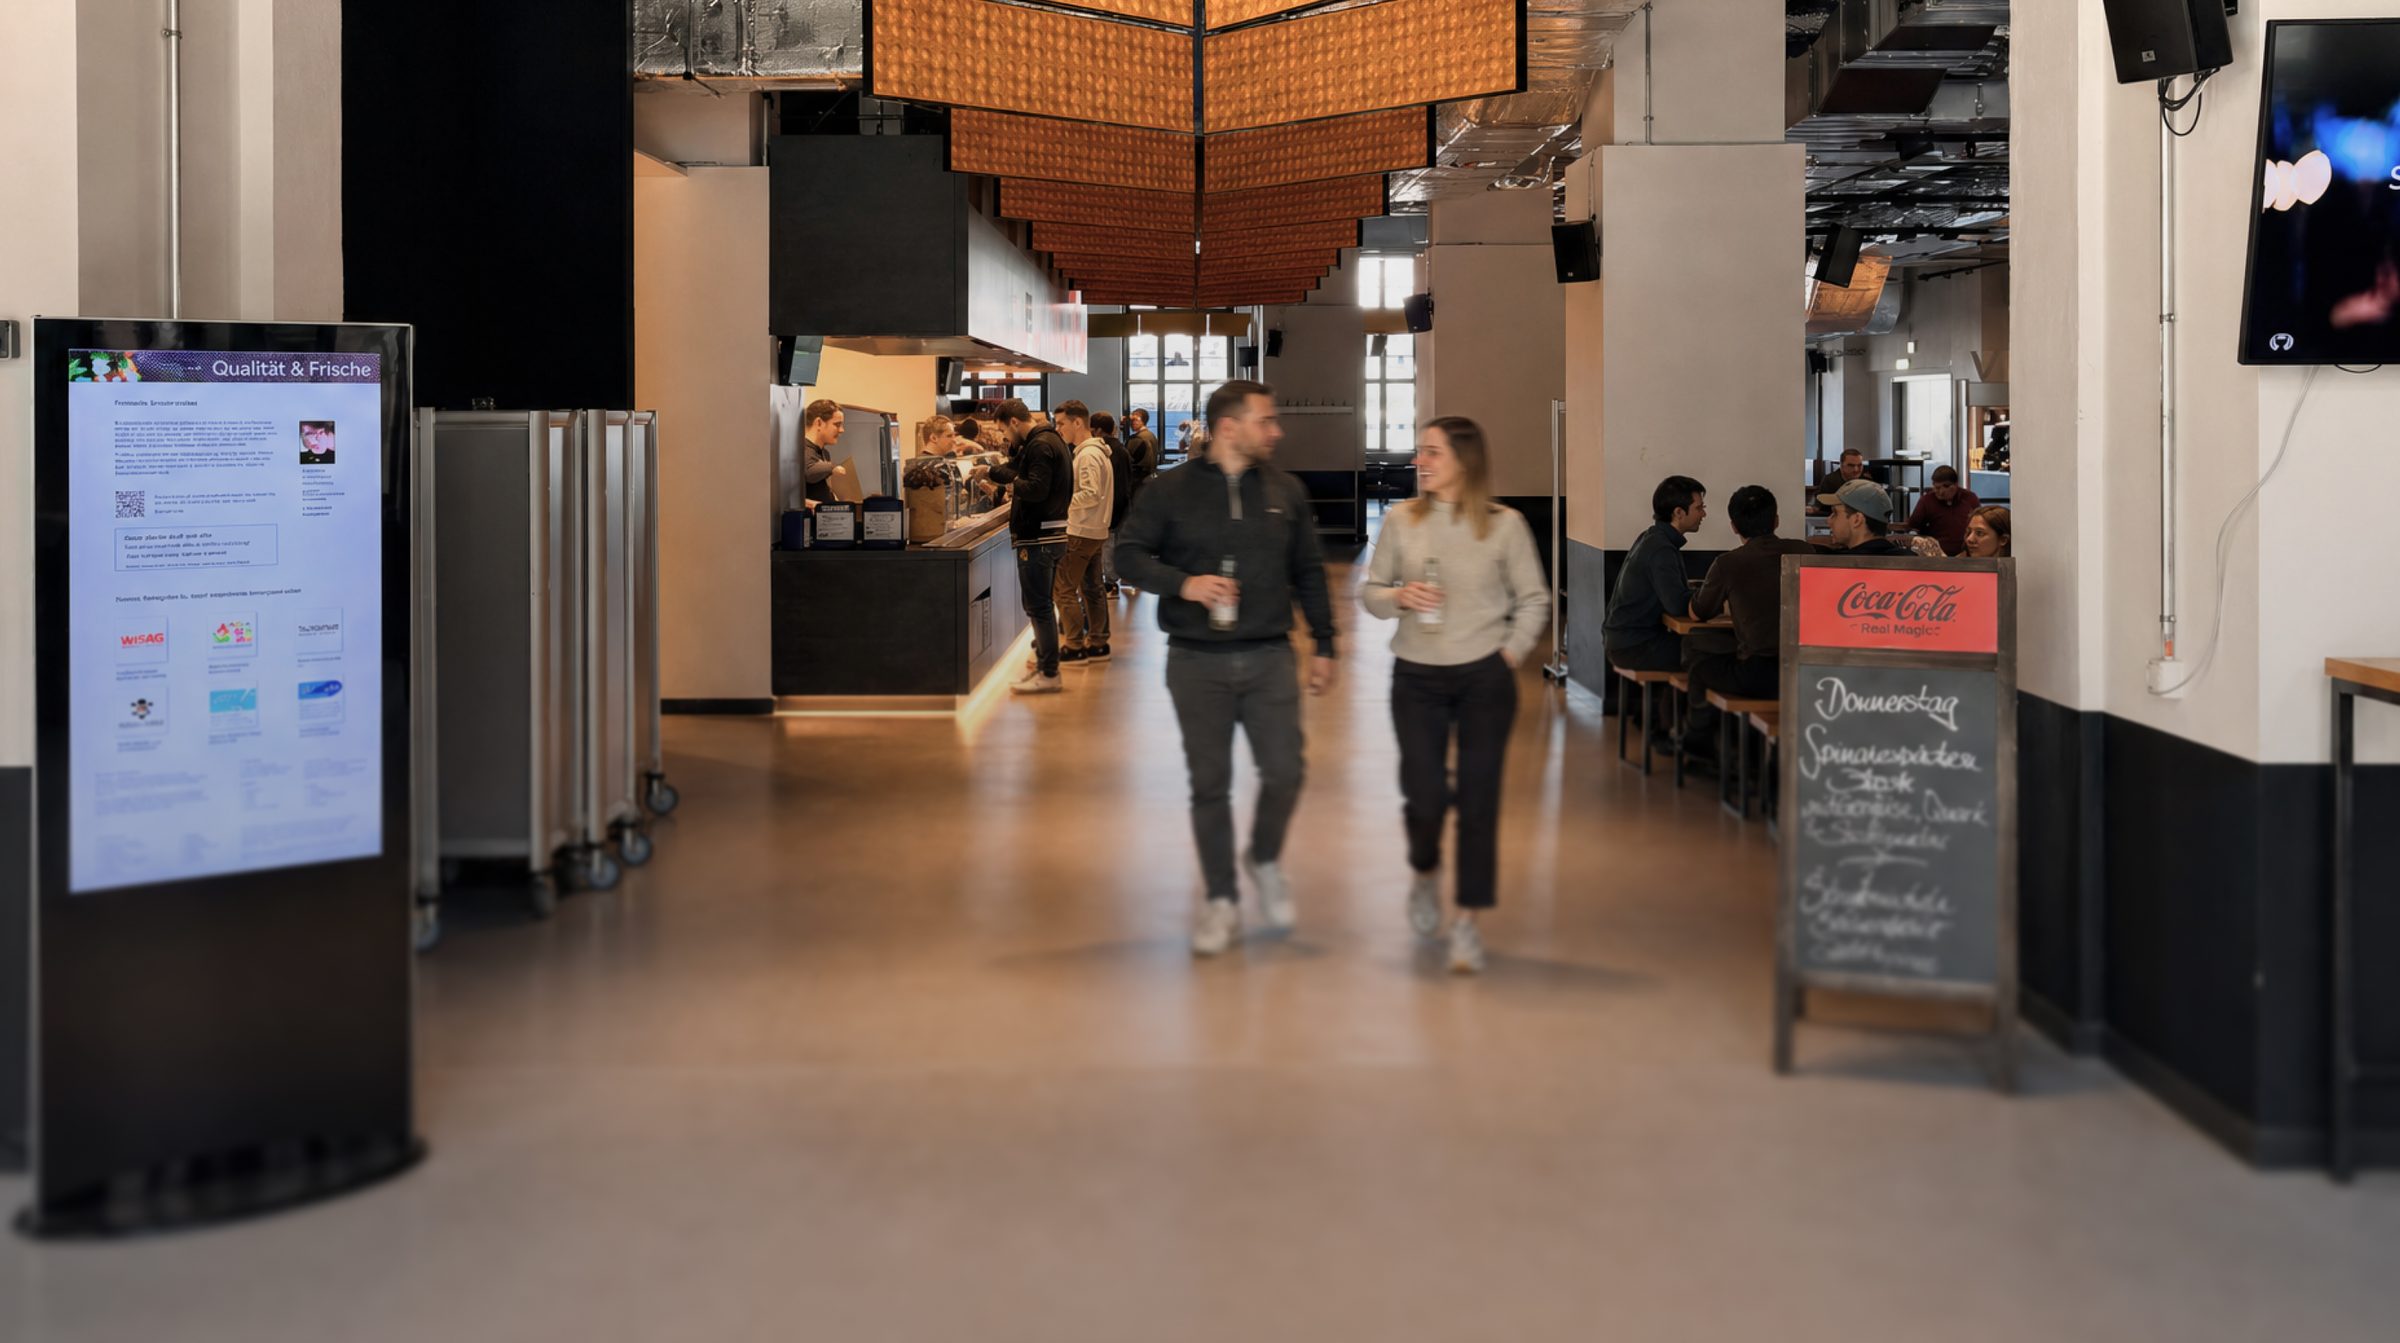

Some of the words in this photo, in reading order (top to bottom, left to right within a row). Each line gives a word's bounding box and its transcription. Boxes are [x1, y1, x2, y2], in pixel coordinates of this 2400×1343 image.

[212, 360, 286, 377] Qualität
[290, 361, 304, 377] &
[309, 361, 372, 377] Frische
[1837, 582, 1964, 622] Coca-Cola
[1861, 623, 1890, 634] Real
[120, 632, 165, 646] WISAG
[1815, 677, 1959, 732] Donnerstag
